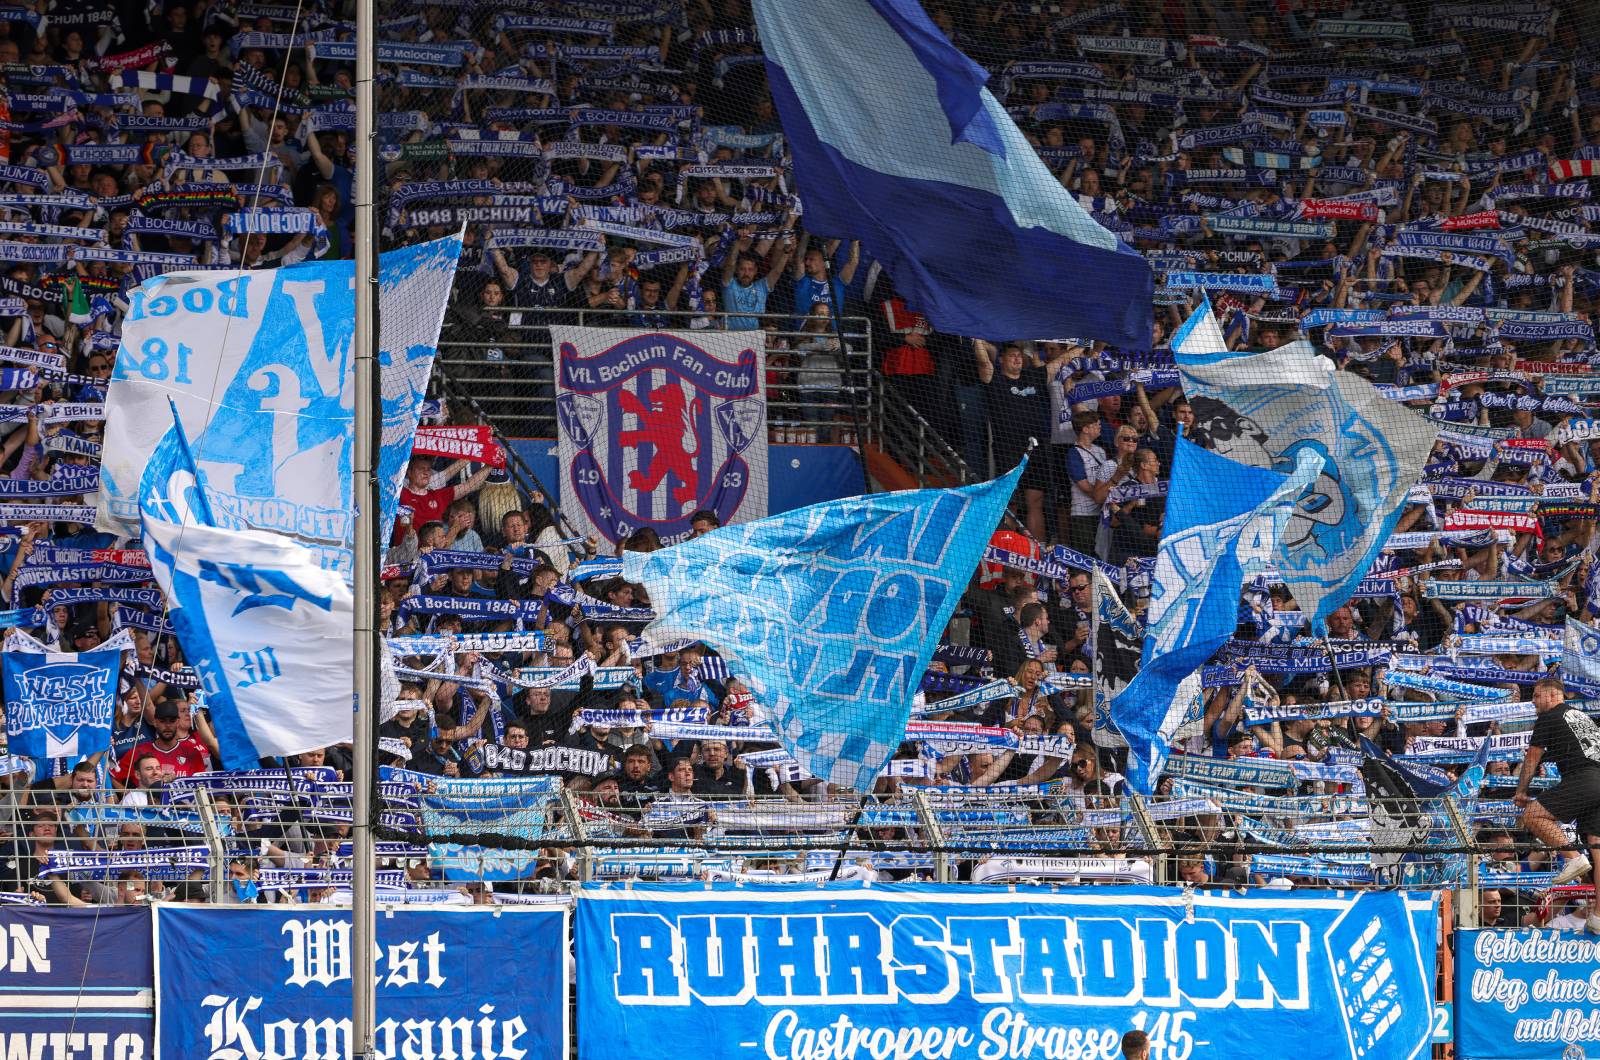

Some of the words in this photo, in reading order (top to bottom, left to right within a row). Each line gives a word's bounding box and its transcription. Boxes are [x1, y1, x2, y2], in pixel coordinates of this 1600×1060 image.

[532, 17, 584, 31] BOCHUM
[1472, 17, 1519, 31] BOCHUM
[393, 50, 446, 63] Malocher
[598, 46, 648, 57] BOCHUM
[1027, 65, 1073, 75] Bochum
[1447, 100, 1493, 116] BOCHUM
[128, 116, 186, 128] BOCHUM
[586, 113, 645, 127] BOCHUM
[1553, 183, 1593, 200] 184
[411, 209, 451, 226] 1848
[456, 207, 531, 224] BOCHUM
[1316, 207, 1358, 216] MÜNCHEN
[38, 224, 98, 238] THEKE
[146, 217, 197, 232] BOCHUM
[1420, 233, 1464, 248] BOCHUM
[127, 251, 192, 265] THEKE
[1195, 274, 1264, 288] BOCHUM
[2, 279, 20, 295] VfL
[22, 284, 64, 304] BOCH
[1428, 312, 1484, 321] BOCHUM
[1380, 326, 1435, 336] BOCHUM
[1500, 324, 1545, 335] STOLZES
[568, 365, 597, 385] VfL
[598, 344, 667, 382] Bochum
[672, 345, 705, 375] Fan
[714, 370, 751, 390] Club
[1524, 362, 1581, 374] MÜNCHEN
[414, 435, 484, 458] DKURVE
[578, 468, 600, 485] 19
[0, 481, 24, 494] VfL
[28, 478, 99, 495] BOCHUM
[14, 507, 75, 518] BOCHUM
[80, 507, 97, 521] 184
[1008, 554, 1068, 581] BOCHUM
[425, 597, 481, 611] Bochum
[485, 600, 516, 614] 1848
[126, 610, 148, 627] VfL
[14, 670, 110, 703] WEST
[7, 698, 114, 736] KOMPANIE
[1433, 736, 1469, 750] GEHTS
[484, 742, 527, 771] 848
[530, 745, 609, 777] BOCHUM
[1025, 858, 1107, 868] RUHRSTADION
[0, 924, 51, 973] N
[281, 918, 447, 989] Wst
[1475, 930, 1523, 966] Geh
[1520, 929, 1596, 963] deinen
[610, 912, 1310, 1009] RUHRSTADION
[1472, 968, 1528, 1012] Weg,
[1532, 968, 1590, 1004] ohne
[1433, 1007, 1450, 1038] 2
[1515, 1009, 1563, 1042] und
[1560, 1008, 1600, 1043] Bele
[763, 1007, 973, 1060] Castroper
[977, 1008, 1122, 1060] Strasse
